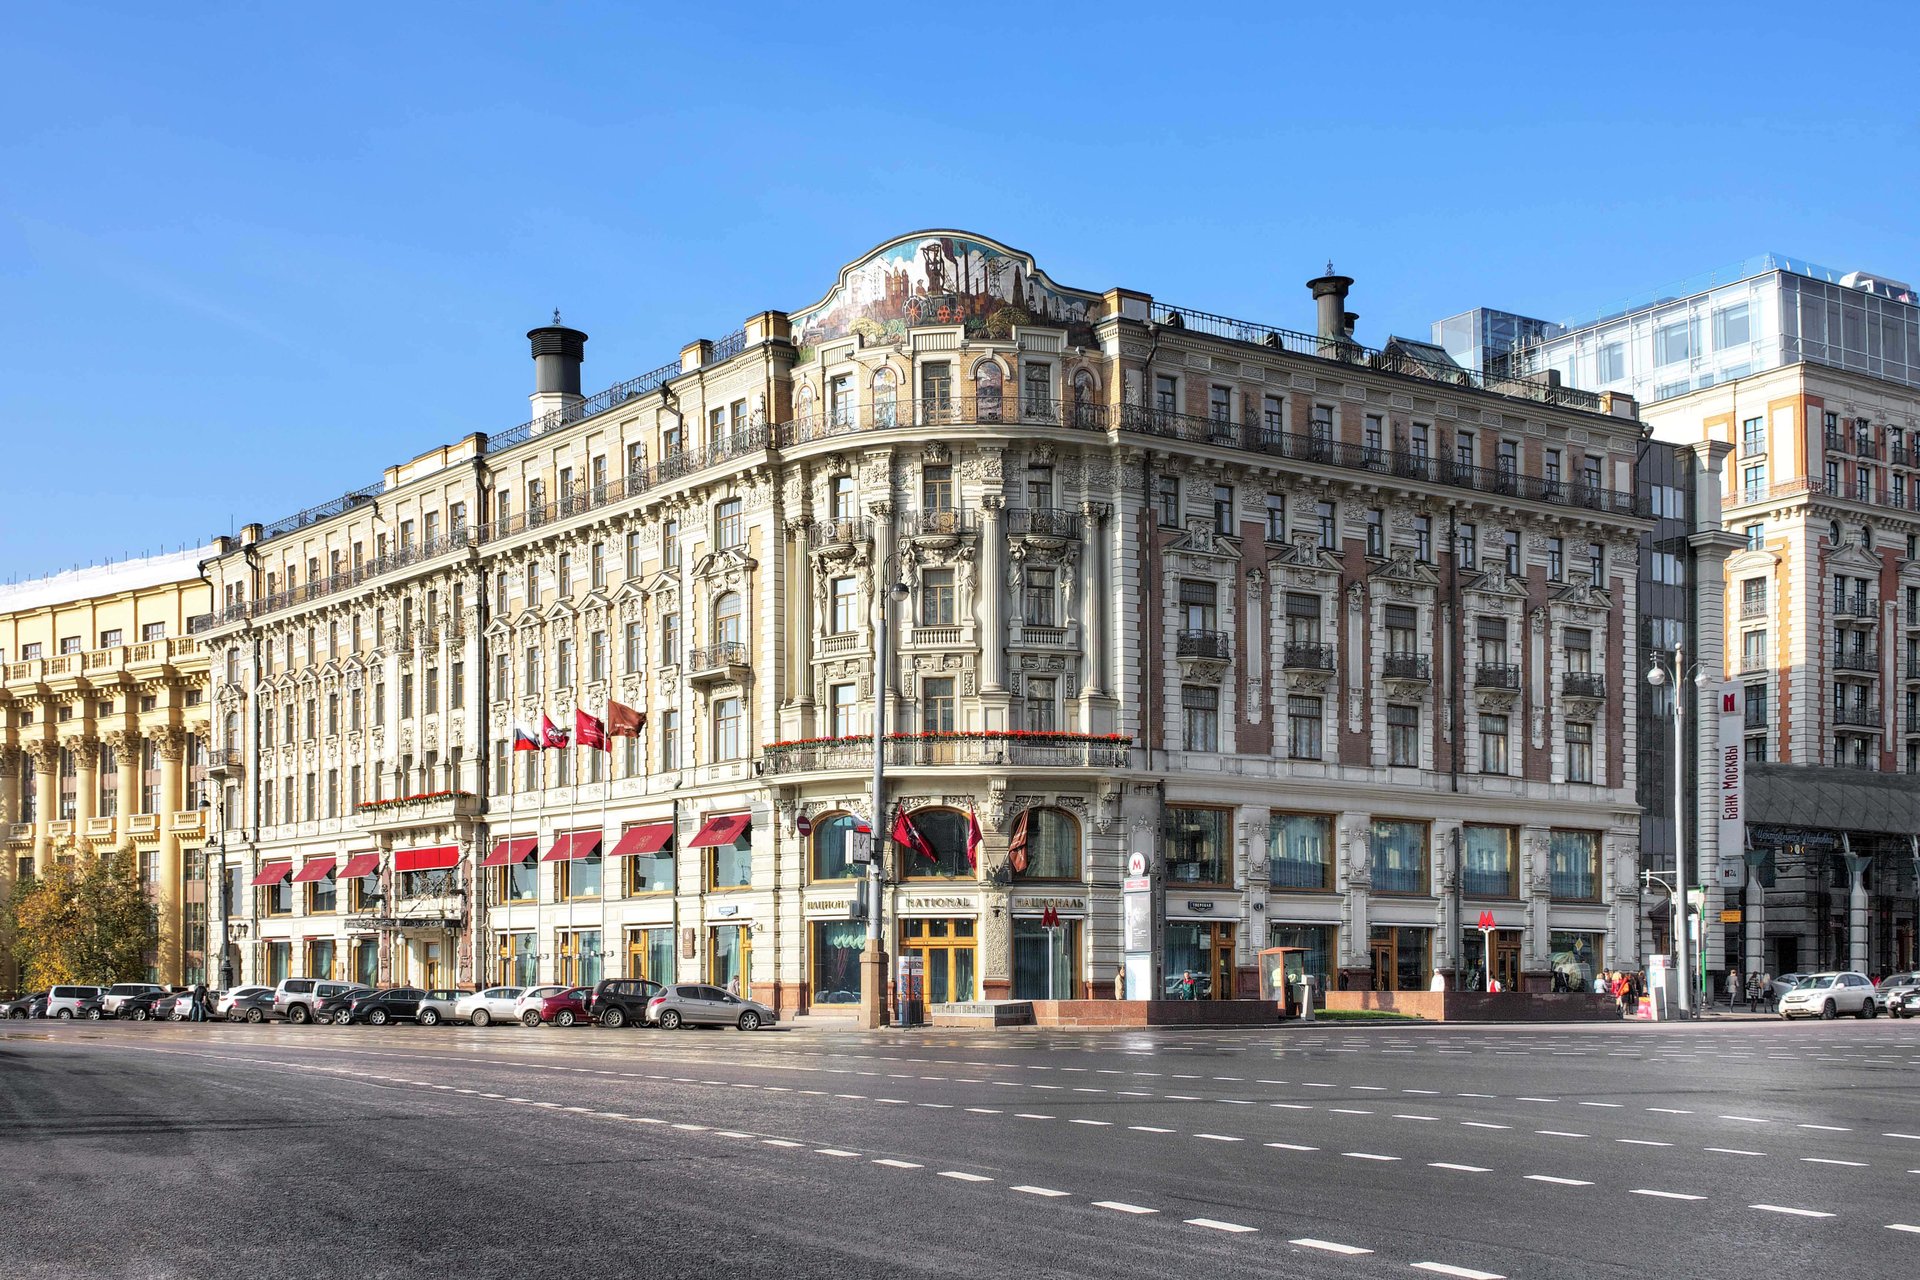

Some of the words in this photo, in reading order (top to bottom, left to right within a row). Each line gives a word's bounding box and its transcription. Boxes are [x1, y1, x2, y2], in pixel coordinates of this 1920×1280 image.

[1722, 745, 1738, 790] Москвы
[1722, 793, 1738, 820] Банк
[905, 897, 971, 908] NATIONAL
[1014, 897, 1084, 908] НАЦИОНАЛЬ
